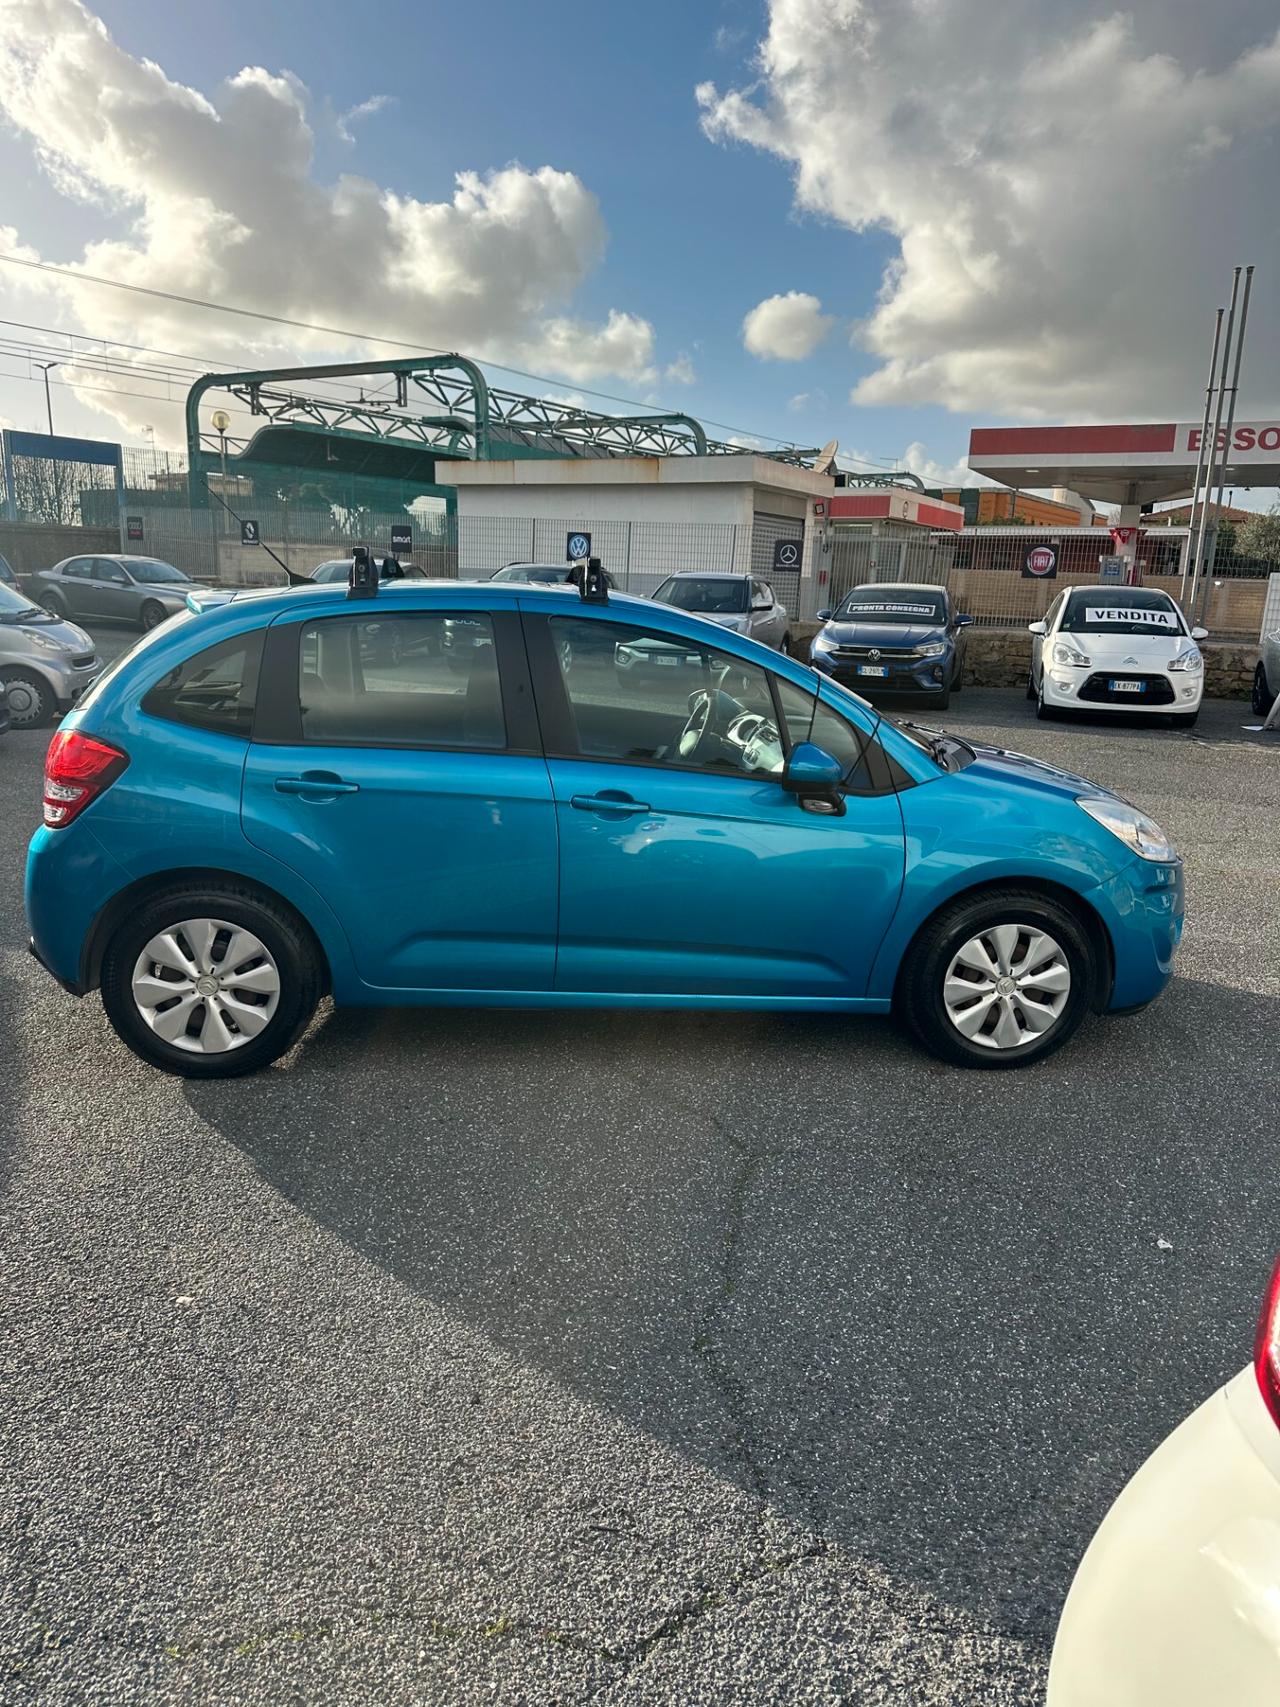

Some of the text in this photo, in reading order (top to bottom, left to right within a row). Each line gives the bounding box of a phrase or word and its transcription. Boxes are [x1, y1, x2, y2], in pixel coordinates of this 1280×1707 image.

[1033, 555, 1050, 567] FIAT
[885, 605, 930, 613] CONSEGNA
[1095, 610, 1168, 623] VENDITA
